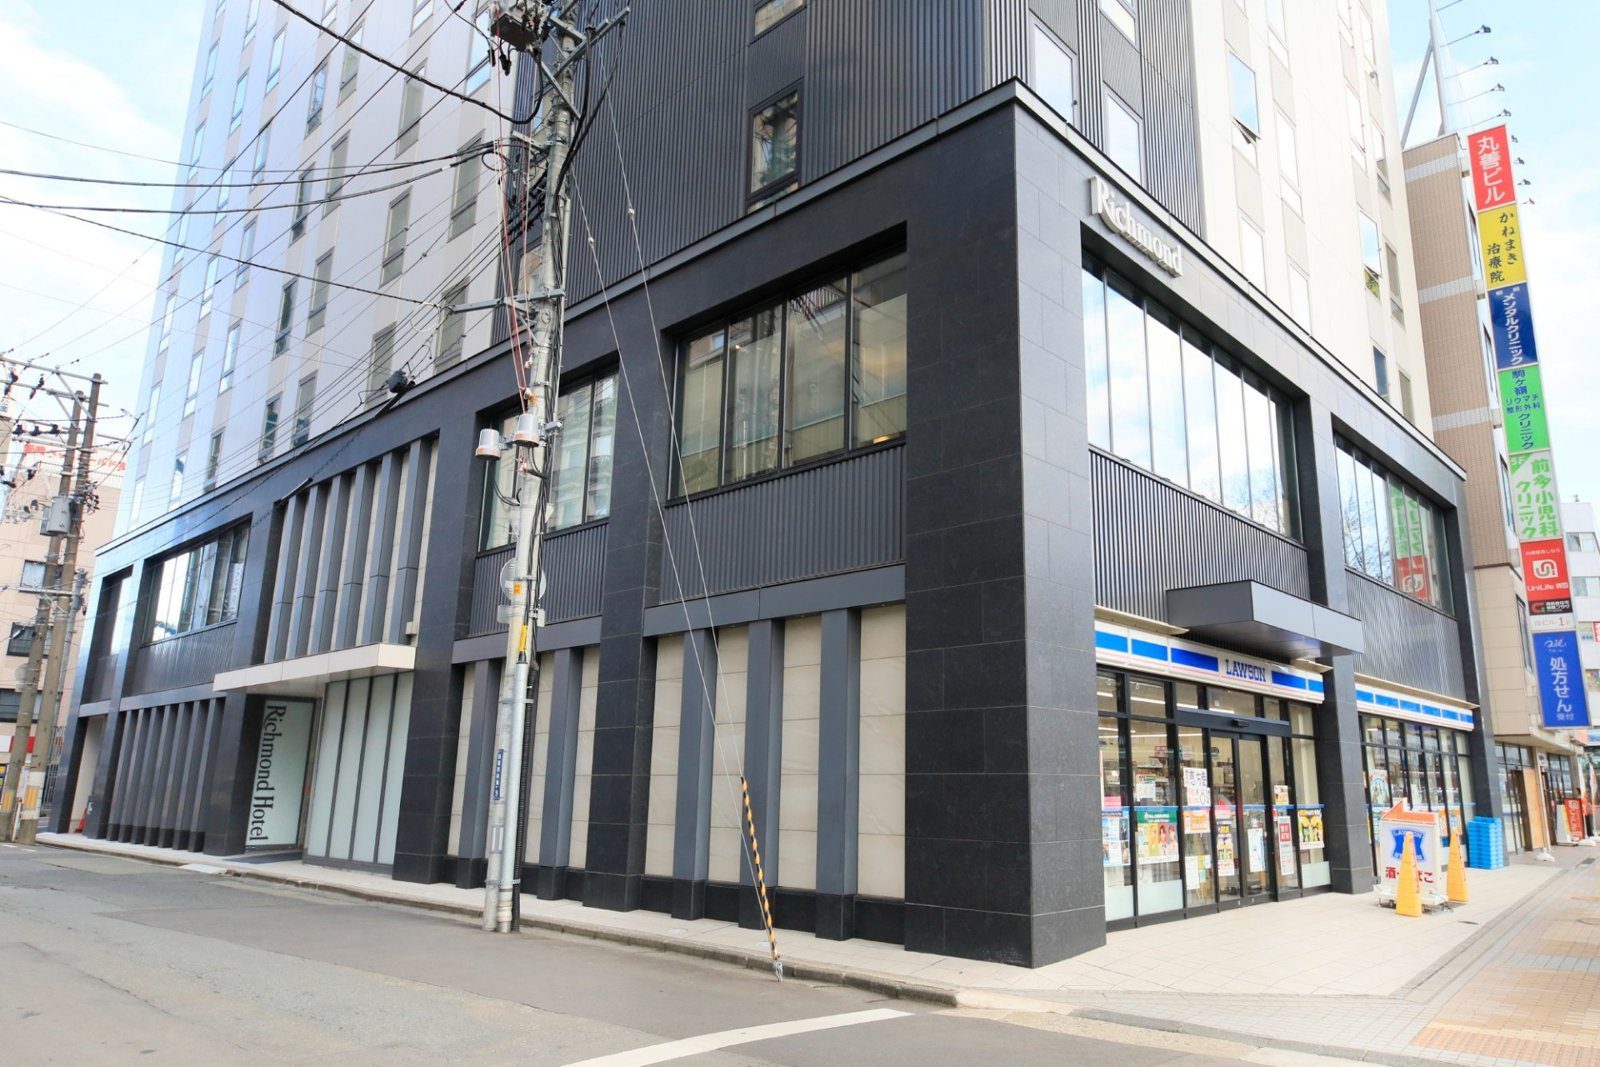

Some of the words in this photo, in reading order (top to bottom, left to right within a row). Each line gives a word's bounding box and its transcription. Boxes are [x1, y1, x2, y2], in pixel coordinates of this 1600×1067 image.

[1476, 135, 1506, 205] 丸善ビル
[1088, 175, 1183, 278] Richmond
[1499, 211, 1518, 265] かねまき
[1487, 243, 1505, 284] 治療院
[1502, 292, 1524, 366] メンタルクリニック
[1506, 392, 1539, 406] リウマチ
[1506, 401, 1541, 414] 整形外科
[1518, 413, 1534, 450] クリニック
[1515, 480, 1537, 539] クリニック
[1531, 458, 1558, 537] 前多小児科
[1528, 583, 1555, 591] UniLife
[1225, 659, 1267, 682] LAWSON
[1549, 656, 1573, 713] 処方せん
[1556, 712, 1575, 721] 受付
[256, 705, 287, 792] Richmond
[249, 796, 275, 841] Hotel
